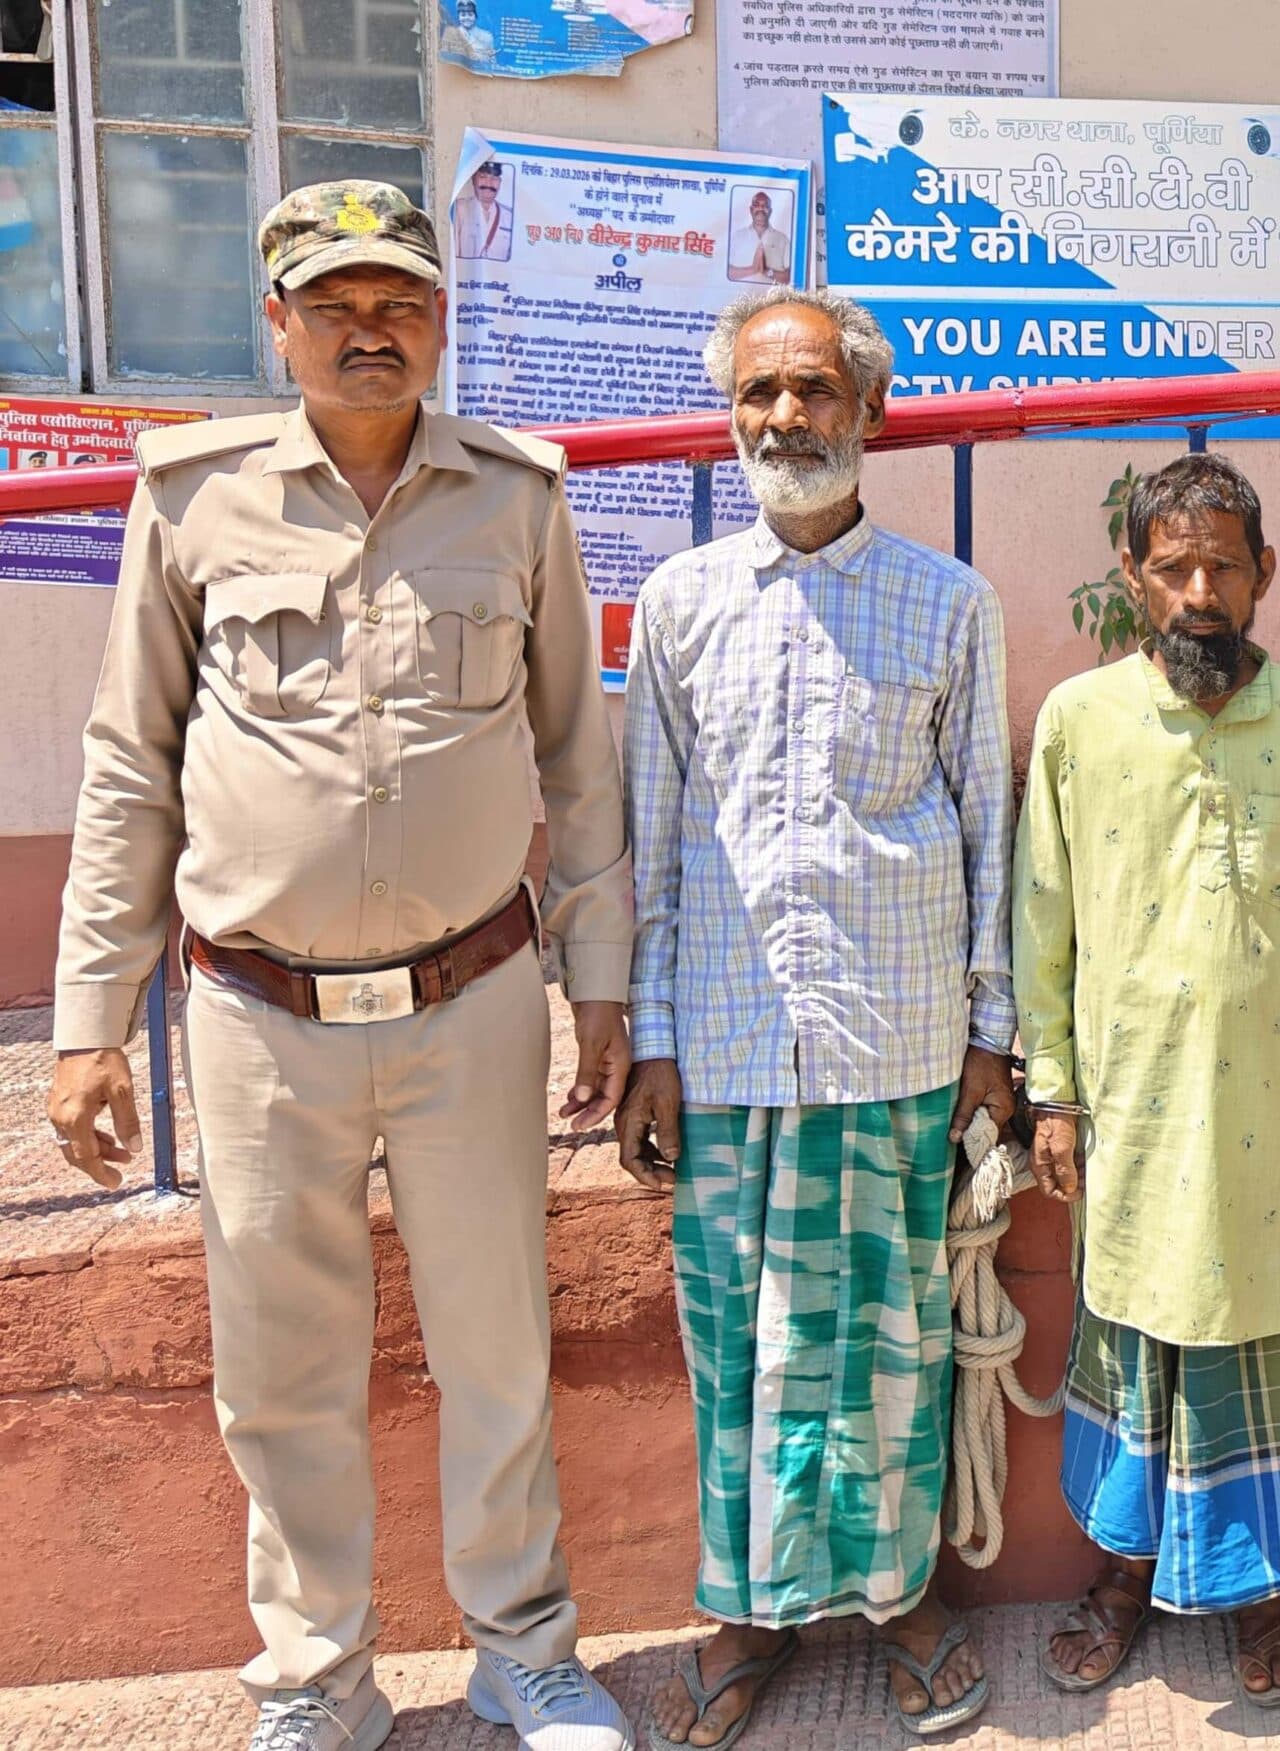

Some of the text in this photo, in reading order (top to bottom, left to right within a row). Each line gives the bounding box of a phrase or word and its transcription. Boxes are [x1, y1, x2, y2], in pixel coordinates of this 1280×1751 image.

[777, 0, 803, 14] पुलिस
[858, 6, 875, 15] द्वारा
[880, 7, 894, 18] गुड
[1011, 12, 1023, 21] को
[1026, 13, 1045, 23] जाने
[742, 14, 754, 25] की
[760, 16, 790, 29] अनुमति
[794, 16, 805, 27] दी
[809, 17, 837, 29] जाएगी
[862, 19, 878, 30] यदि
[883, 22, 897, 34] गुड
[941, 25, 956, 34] उस
[960, 24, 985, 35] मामले
[1000, 28, 1022, 37] गवाह
[1026, 27, 1045, 38] बनने
[742, 31, 754, 40] का
[803, 32, 822, 43] होता
[823, 33, 830, 44] है
[831, 33, 842, 44] तो
[843, 34, 867, 45] उससे
[868, 35, 887, 46] आगे
[889, 34, 907, 47] कोई
[909, 38, 940, 50] पूछताछ
[959, 38, 971, 49] की
[743, 74, 769, 89] पुलिस
[771, 75, 809, 89] अधिकारी
[811, 79, 830, 90] द्वारा
[831, 79, 846, 90] एक
[849, 79, 857, 91] ही
[875, 82, 906, 95] पूछताछ
[907, 81, 916, 92] के
[973, 84, 995, 96] किया
[828, 65, 850, 75] समय
[854, 64, 869, 76] ऐसे
[872, 67, 887, 79] गुड
[931, 69, 943, 78] का
[946, 70, 962, 82] पूरा
[992, 72, 1002, 81] या
[1032, 74, 1046, 83] पत्र
[949, 115, 1223, 154] के. नगर थाना, पूर्णिया
[549, 167, 591, 181] 29.03.2026
[591, 168, 602, 182] को
[603, 169, 621, 184] बिहार
[621, 171, 642, 187] पुलिस
[912, 153, 1253, 211] आप सी.सी.टी.वी
[583, 185, 664, 208] के होने वाले चुनाव में
[611, 209, 624, 222] पद
[628, 208, 638, 221] के
[639, 209, 676, 224] उम्मीदवार
[587, 223, 634, 249] वीरेन्द्र
[635, 232, 682, 255] कुमार
[682, 231, 716, 257] सिंह
[845, 207, 960, 264] कैमरे
[969, 208, 1034, 265] की
[1042, 211, 1222, 269] निगरानी
[1229, 215, 1278, 269] में
[594, 271, 644, 291] अपील
[902, 316, 1276, 360] YOU ARE UNDER
[888, 374, 974, 398] CTV
[0, 409, 38, 429] पुलिस
[122, 417, 170, 438] पूर्णि
[50, 430, 70, 449] हेतु
